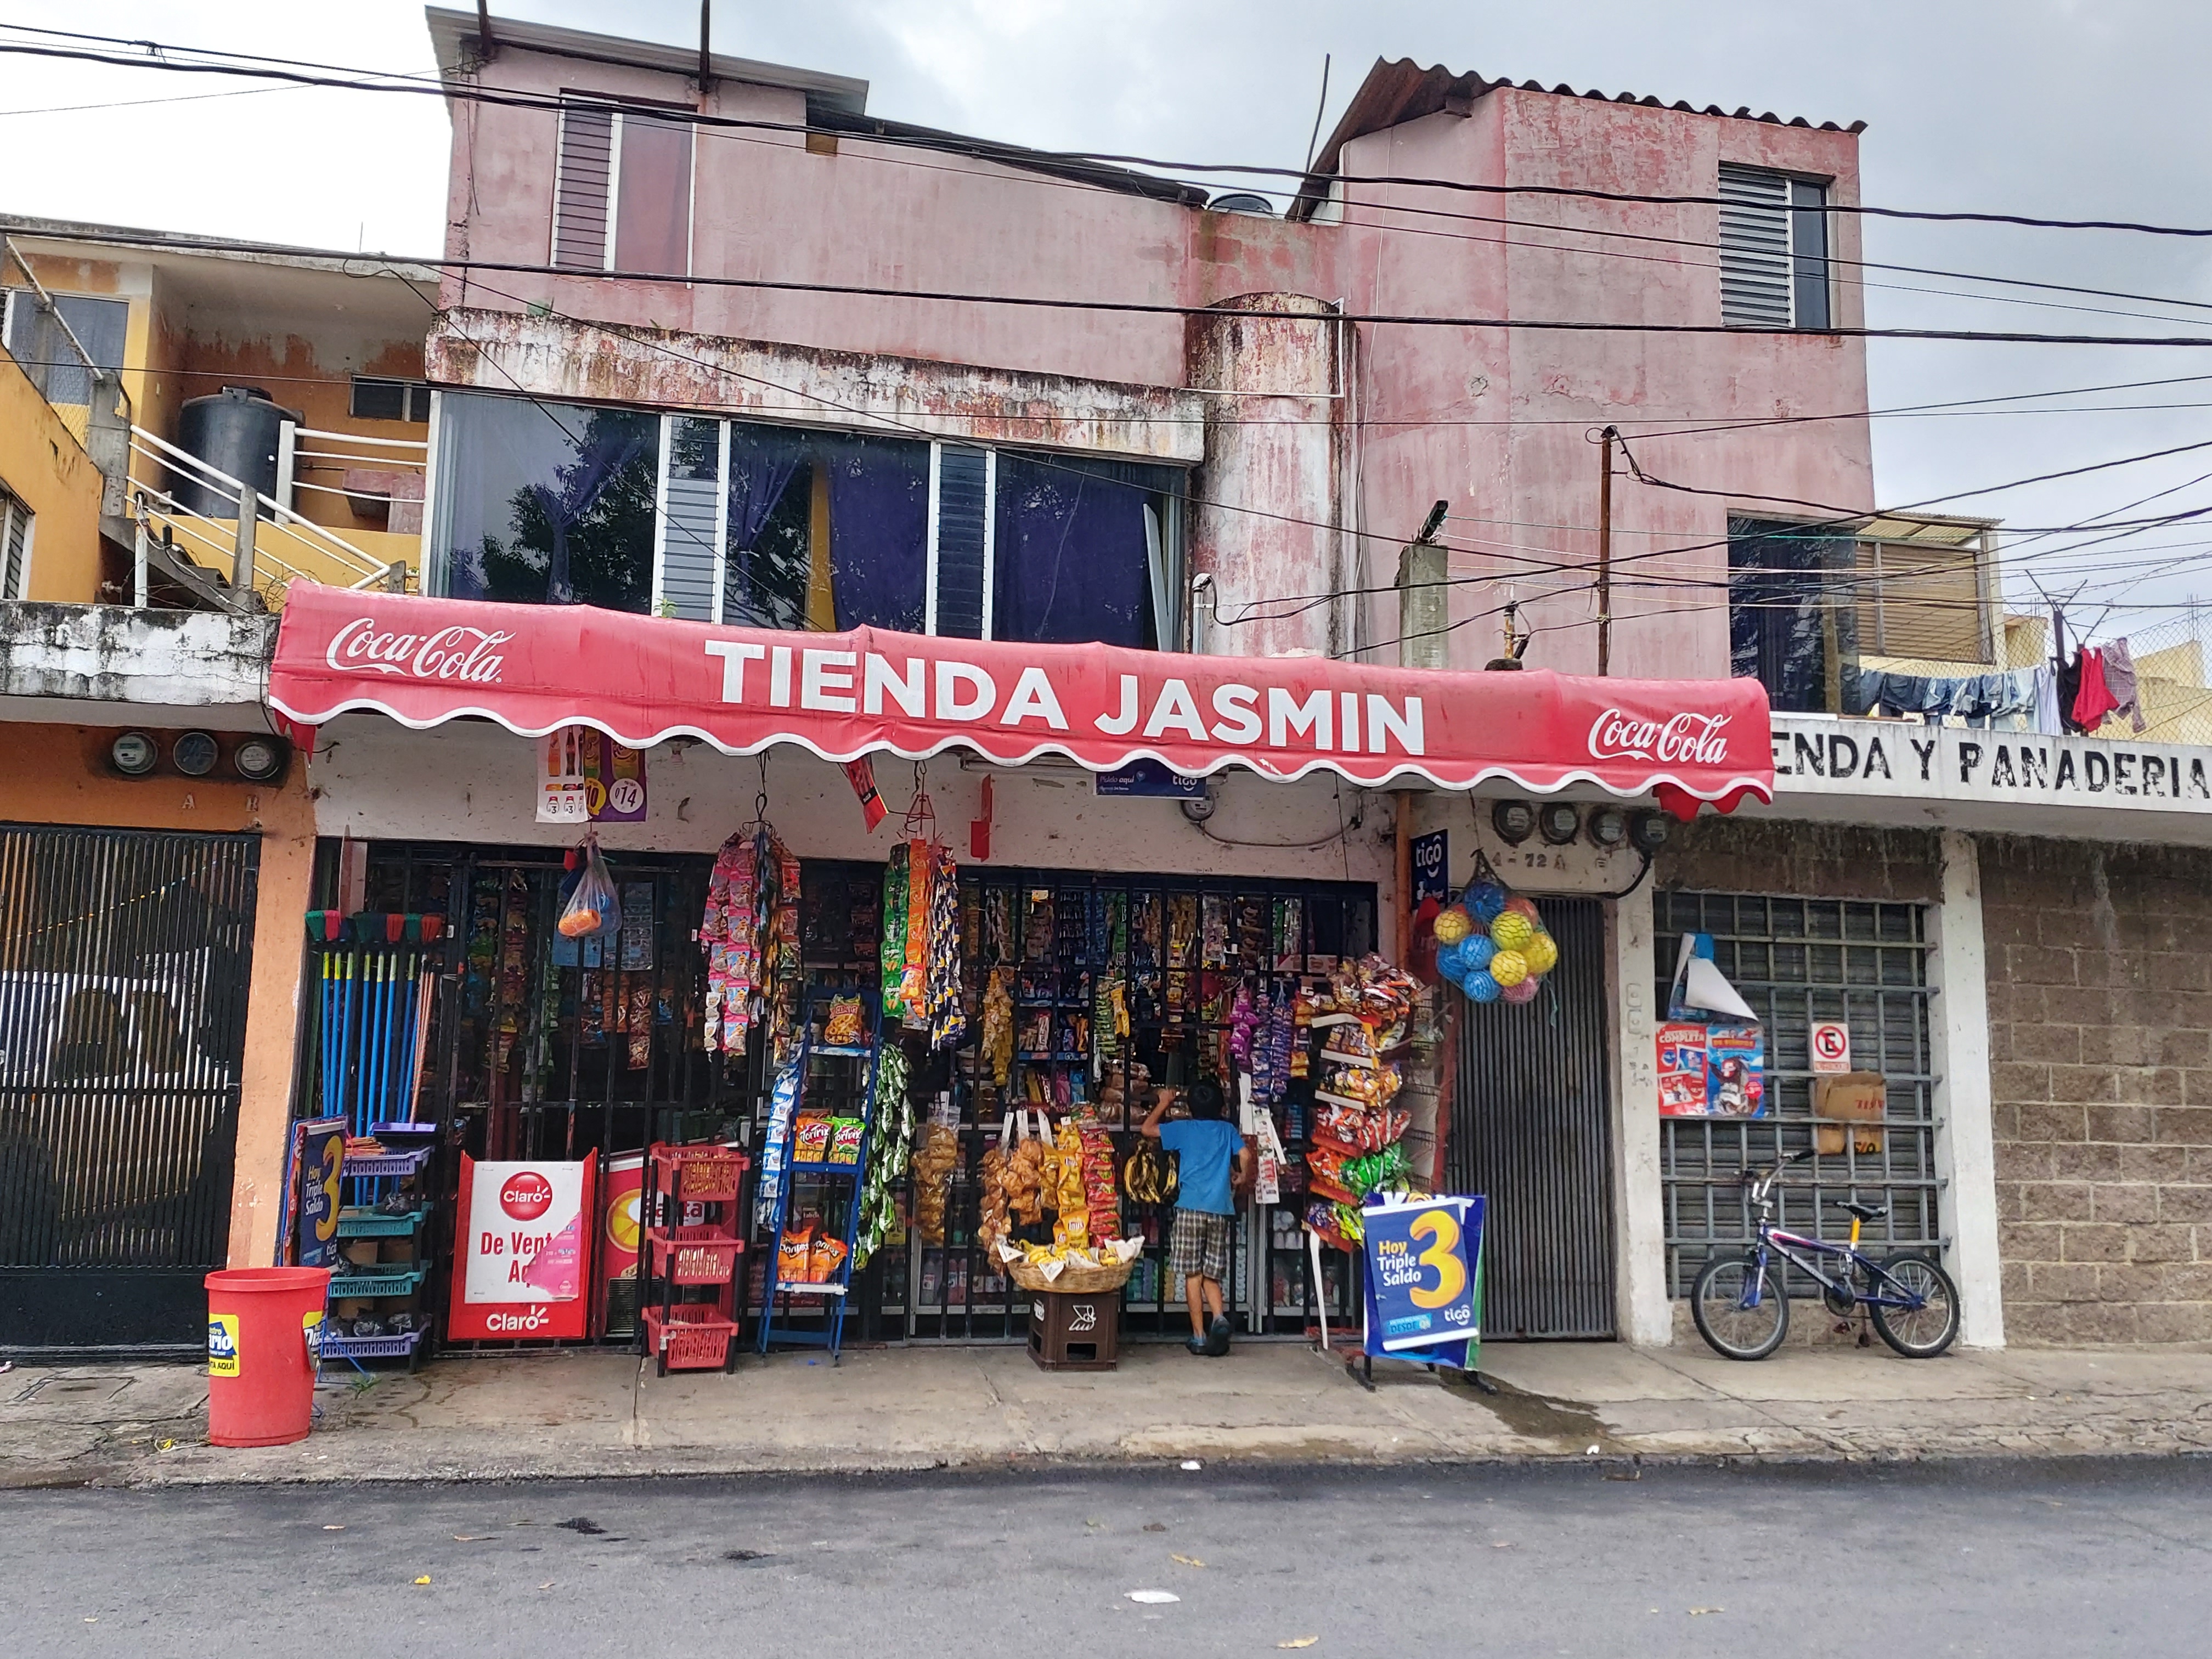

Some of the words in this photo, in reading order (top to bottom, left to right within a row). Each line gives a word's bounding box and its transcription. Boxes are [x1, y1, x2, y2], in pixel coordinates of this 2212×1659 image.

[326, 618, 516, 682] Coca-Cola
[704, 640, 1069, 730] TIENDA
[1094, 674, 1425, 755] JASMIN
[1588, 708, 1733, 764] Coca-Cola
[1910, 739, 1936, 781] Y
[1959, 742, 2212, 800] PANADERIA
[1119, 775, 1134, 785] aquí
[1173, 775, 1197, 791] tigo
[182, 794, 196, 809] A
[1416, 835, 1442, 877] tigo
[308, 1165, 321, 1182] Hoy
[306, 1180, 323, 1199] Triple
[315, 1135, 343, 1242] 3
[503, 1186, 550, 1203] Claro
[306, 1198, 323, 1216] Saldo
[481, 1232, 504, 1255] De
[1379, 1240, 1407, 1256] Hoy
[1376, 1253, 1416, 1272] Triple
[1409, 1210, 1466, 1308] 3
[1383, 1268, 1422, 1286] Saldo
[487, 1305, 549, 1331] Claro
[1444, 1304, 1471, 1326] tigo
